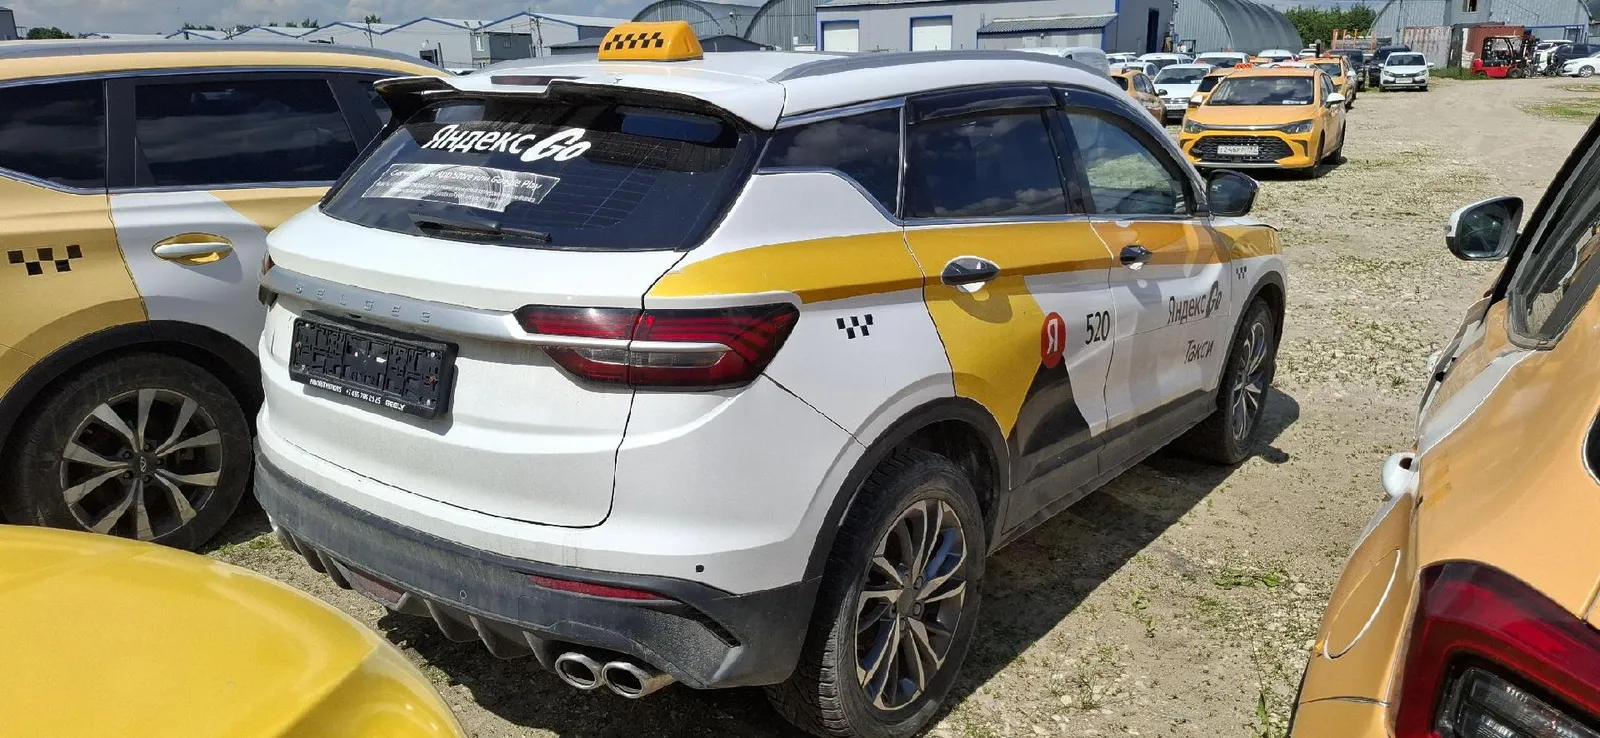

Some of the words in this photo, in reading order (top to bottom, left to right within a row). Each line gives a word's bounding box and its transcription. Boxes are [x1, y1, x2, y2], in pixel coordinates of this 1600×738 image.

[421, 124, 536, 154] Яндекс
[520, 127, 592, 163] Go
[521, 179, 543, 191] Play
[1167, 295, 1206, 325] Яндекс
[1206, 280, 1222, 318] Go
[1046, 318, 1059, 354] Я
[1084, 310, 1111, 346] 520
[1184, 339, 1215, 365] Такси
